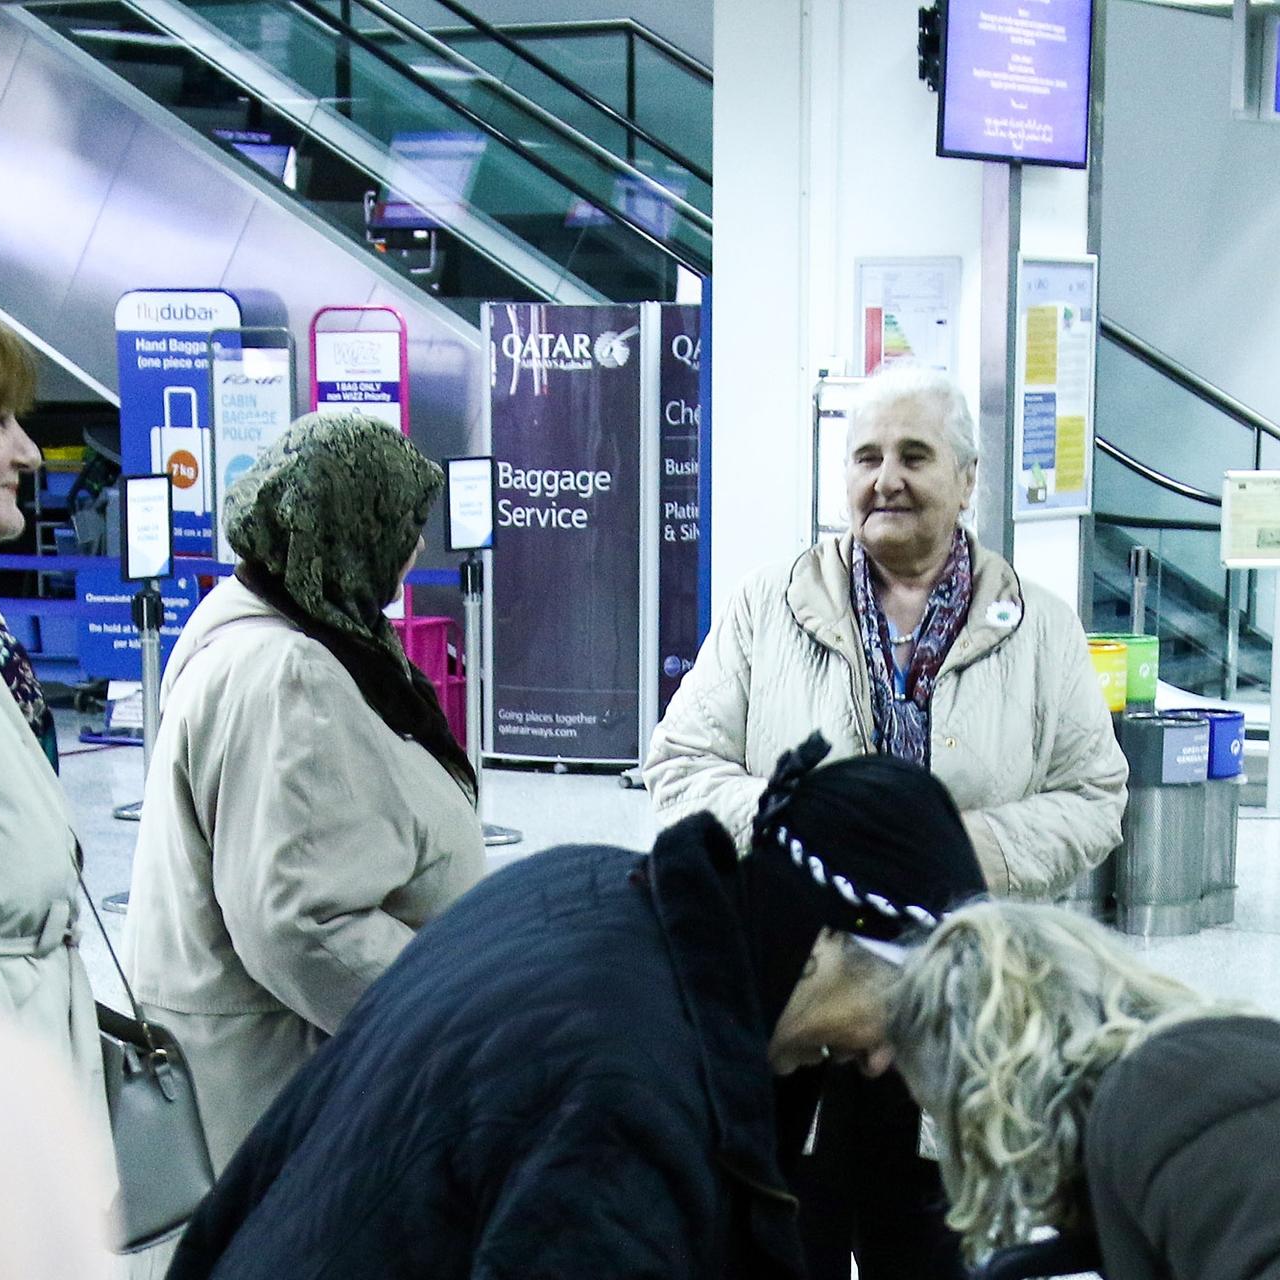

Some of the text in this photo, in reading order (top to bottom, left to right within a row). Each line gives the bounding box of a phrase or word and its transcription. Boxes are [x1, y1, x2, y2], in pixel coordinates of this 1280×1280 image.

[137, 303, 214, 322] flydubai
[135, 338, 221, 355] Hand Baggae
[502, 333, 592, 361] QATAR
[163, 356, 192, 370] piece
[221, 394, 257, 408] CABIN
[222, 410, 277, 425] BAGGAGE
[222, 427, 262, 441] POLICY
[497, 461, 611, 498] Baggage
[498, 499, 588, 528] Service
[664, 523, 676, 542] &
[498, 708, 523, 723] Going
[555, 712, 597, 726] together
